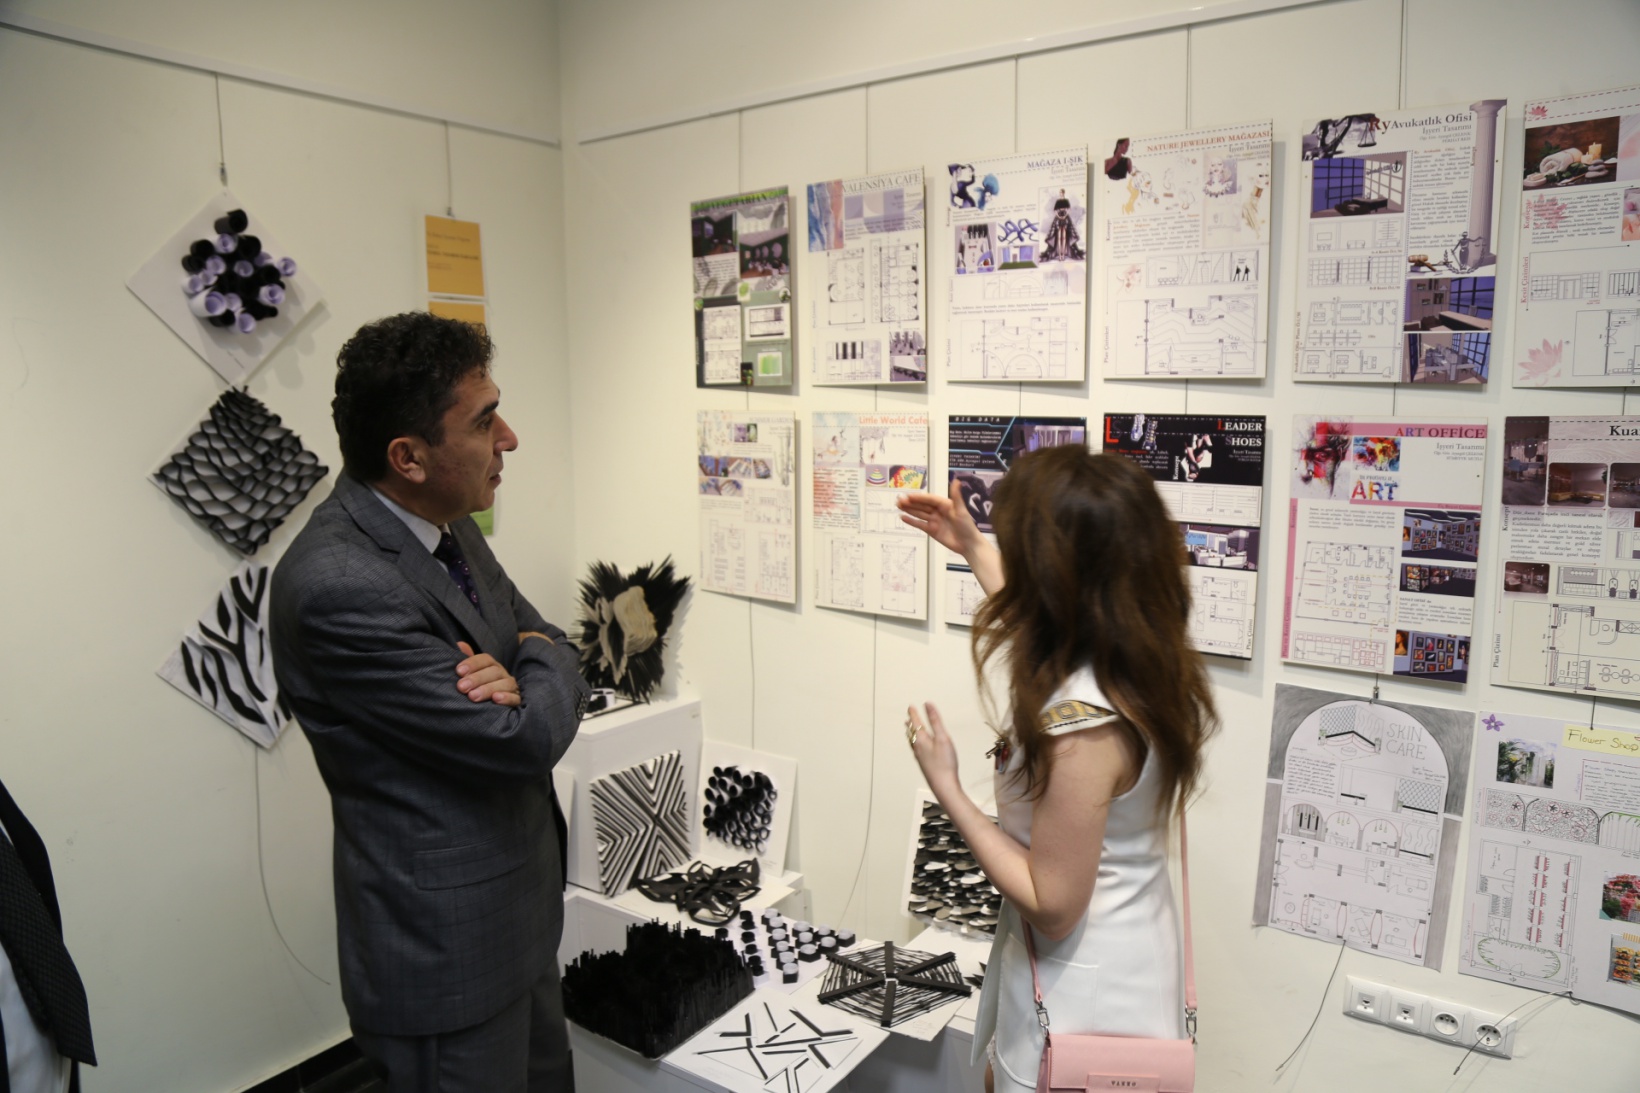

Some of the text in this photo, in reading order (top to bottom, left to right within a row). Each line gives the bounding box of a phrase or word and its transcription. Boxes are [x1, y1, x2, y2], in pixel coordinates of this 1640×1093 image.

[1391, 116, 1442, 130] Avukatlık
[1445, 112, 1472, 125] Ofisi
[1147, 130, 1271, 152] NATURE JEWELLERY MAĞAZASI
[1027, 158, 1062, 168] MAĞAZA
[859, 416, 879, 425] Little
[880, 416, 906, 425] World
[1217, 418, 1262, 432] LEADER
[1395, 427, 1424, 438] ART
[1610, 425, 1640, 436] Kua
[1225, 436, 1262, 448] SHOES
[1172, 456, 1180, 480] Konsept
[1352, 480, 1398, 501] ART
[1502, 505, 1510, 532] Konsept
[1492, 655, 1500, 668] Plan
[1386, 722, 1422, 742] SKIN
[1568, 728, 1639, 752] Flower Shop
[1386, 740, 1428, 760] CARE
